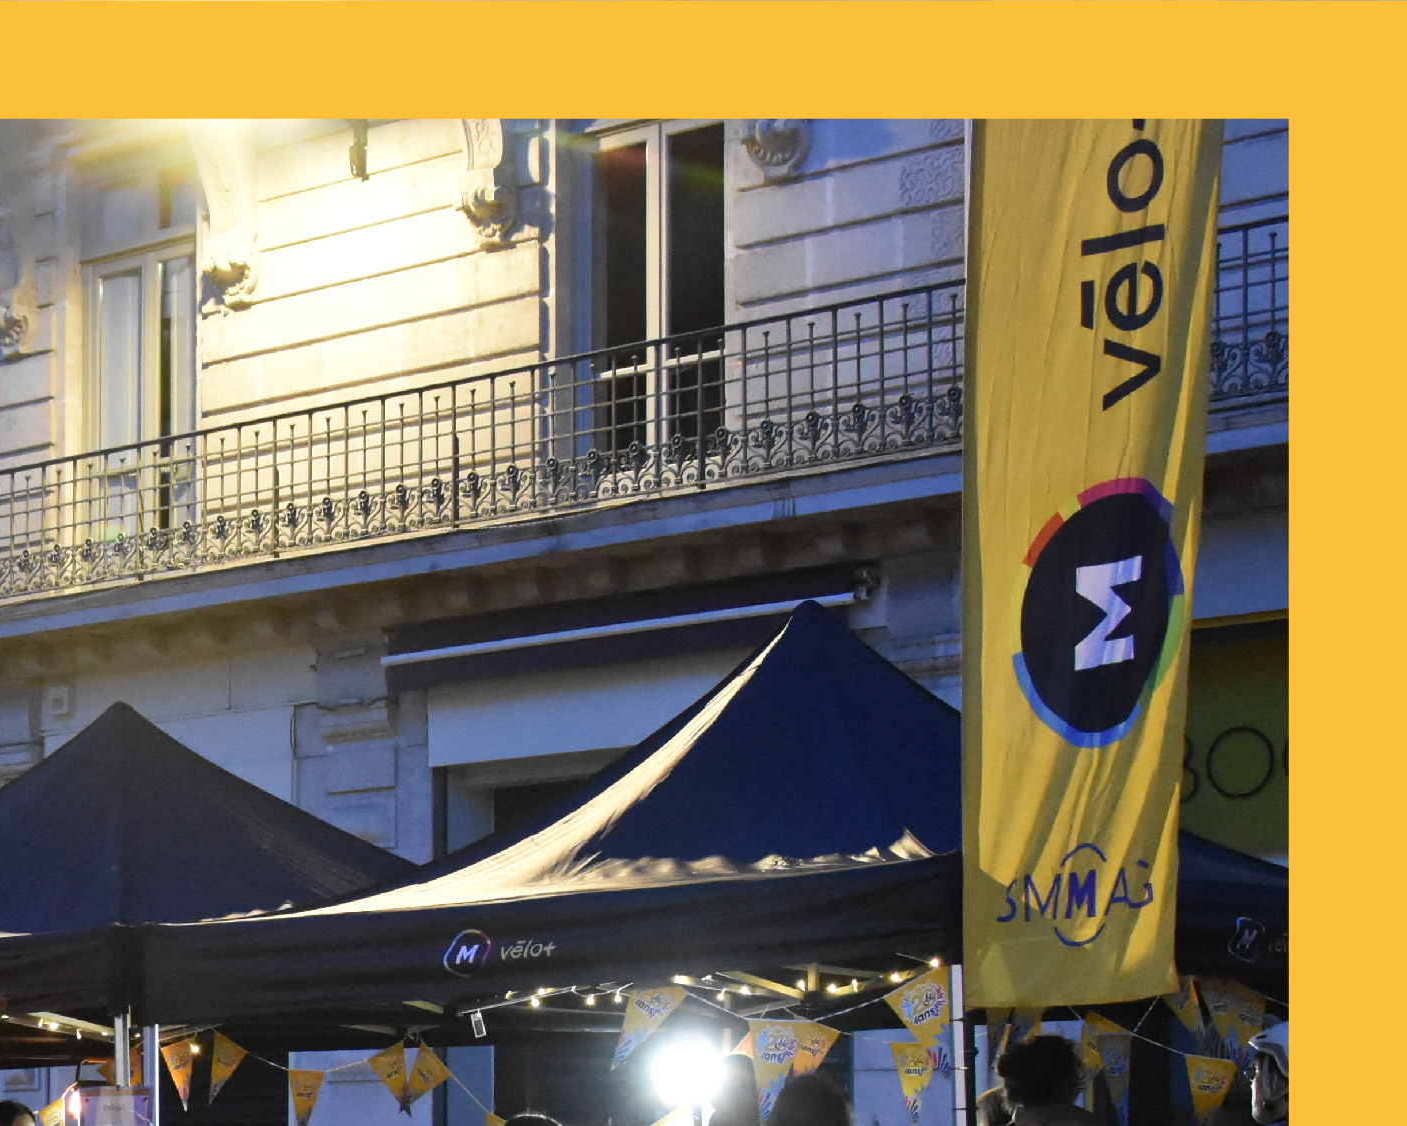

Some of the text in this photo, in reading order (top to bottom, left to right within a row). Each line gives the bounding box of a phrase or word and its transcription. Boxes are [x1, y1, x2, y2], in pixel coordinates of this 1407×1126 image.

[1081, 119, 1165, 411] vēlo
[1074, 555, 1142, 670] M
[456, 944, 480, 965] M
